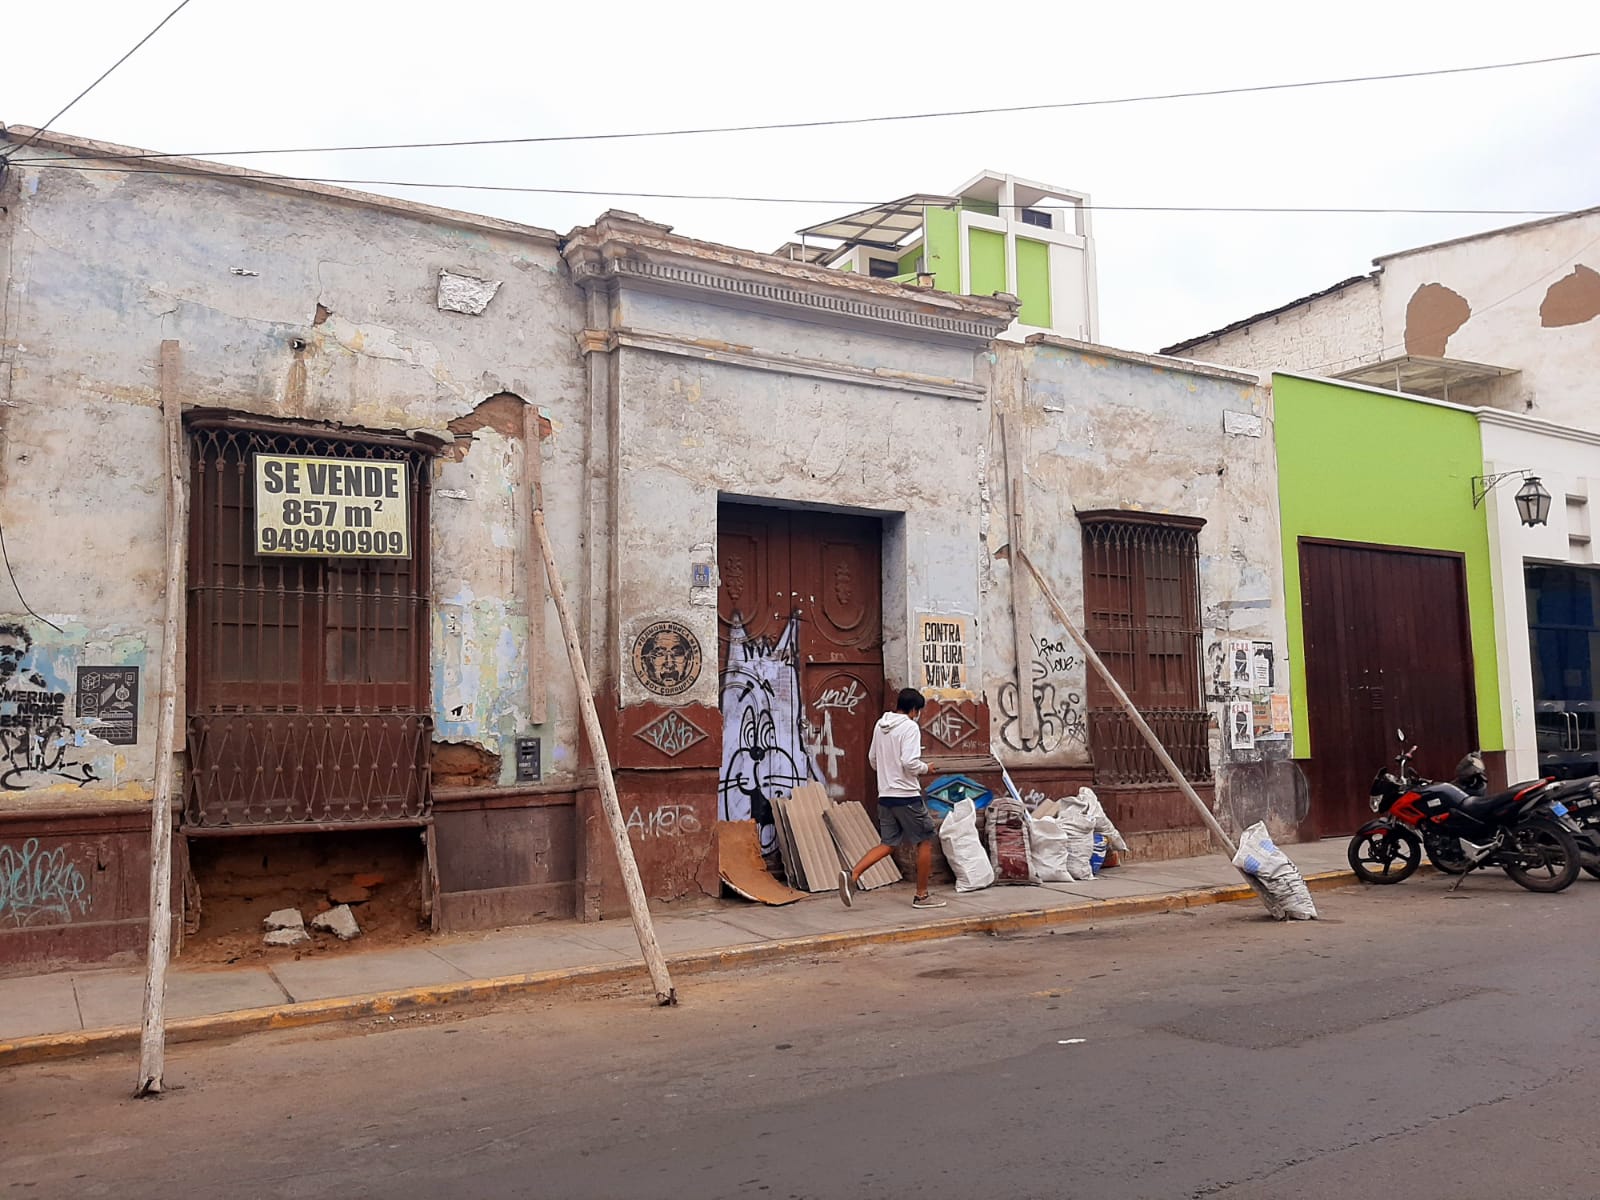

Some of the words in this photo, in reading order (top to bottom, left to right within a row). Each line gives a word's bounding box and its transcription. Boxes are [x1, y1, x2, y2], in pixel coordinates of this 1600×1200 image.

[264, 461, 301, 494] SE
[307, 463, 399, 498] VENDE
[282, 499, 338, 527] 857
[262, 527, 404, 554] 949490909
[925, 622, 961, 643] CONTRA
[922, 643, 963, 665] CULTURA
[3, 689, 66, 704] MERINO
